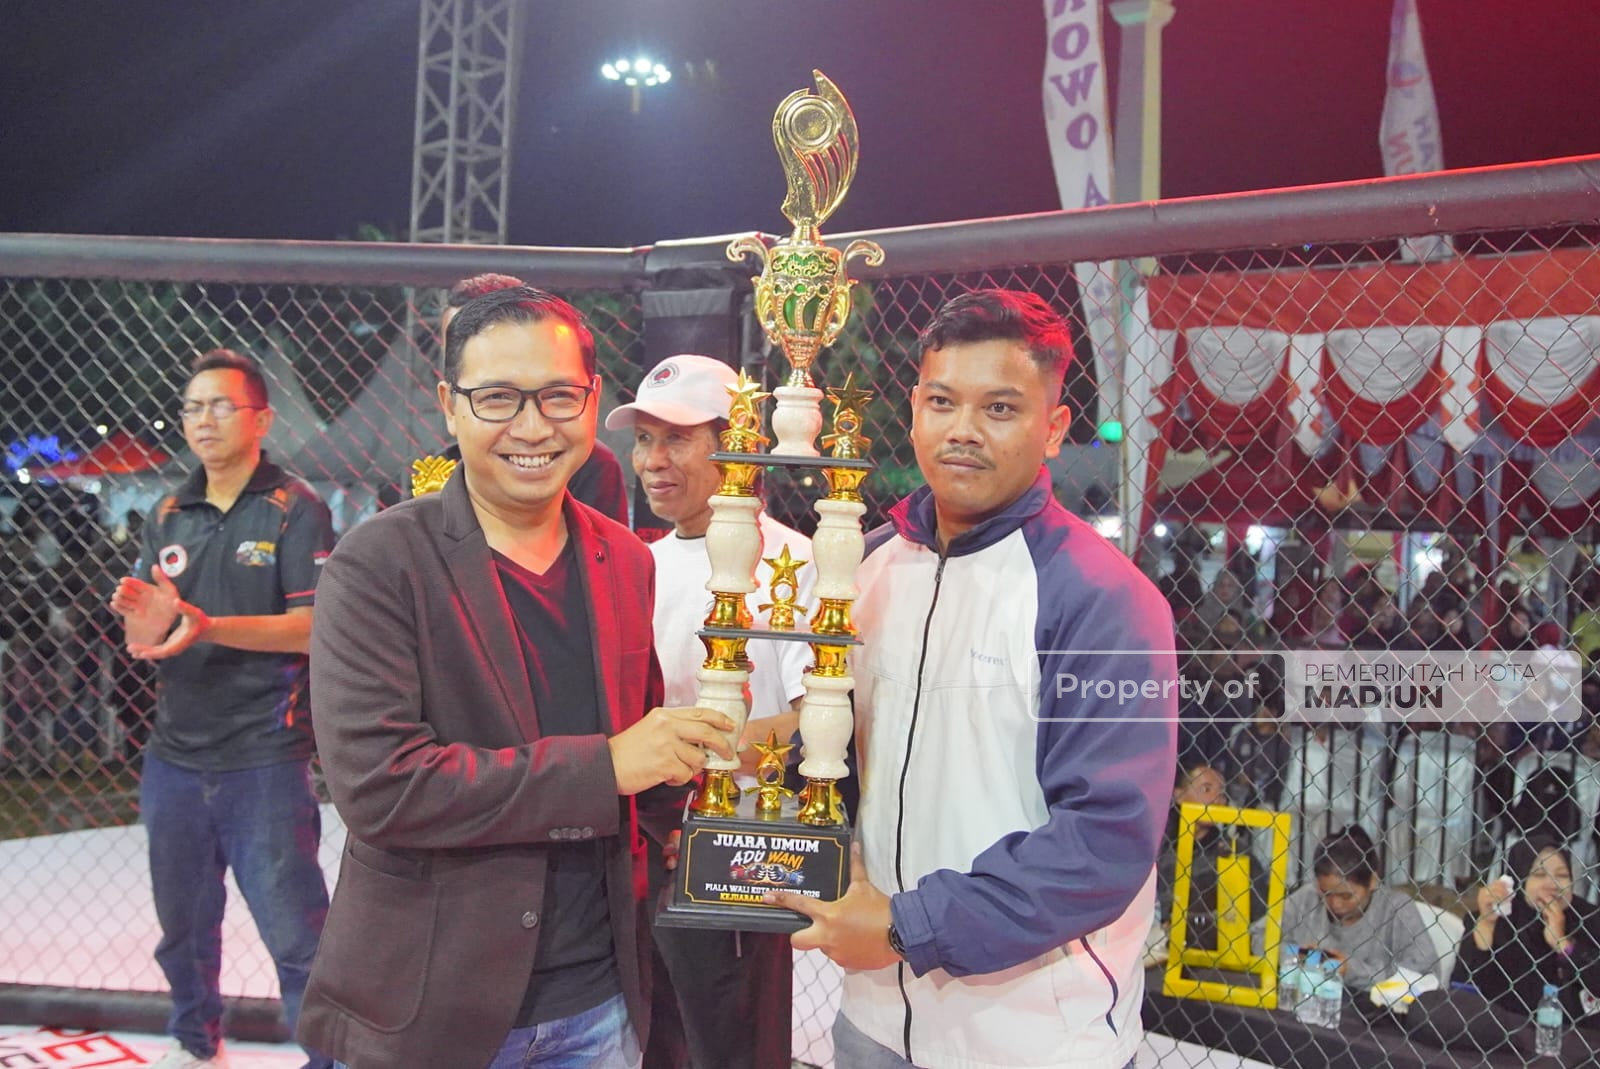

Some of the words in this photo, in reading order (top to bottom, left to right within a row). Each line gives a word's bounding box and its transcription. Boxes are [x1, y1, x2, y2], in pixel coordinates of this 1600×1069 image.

[713, 834, 767, 849] JUARA
[771, 837, 820, 852] UMUM
[731, 850, 766, 866] ADU
[767, 851, 804, 870] WANI
[705, 883, 728, 892] PIALA
[729, 884, 750, 893] WALI
